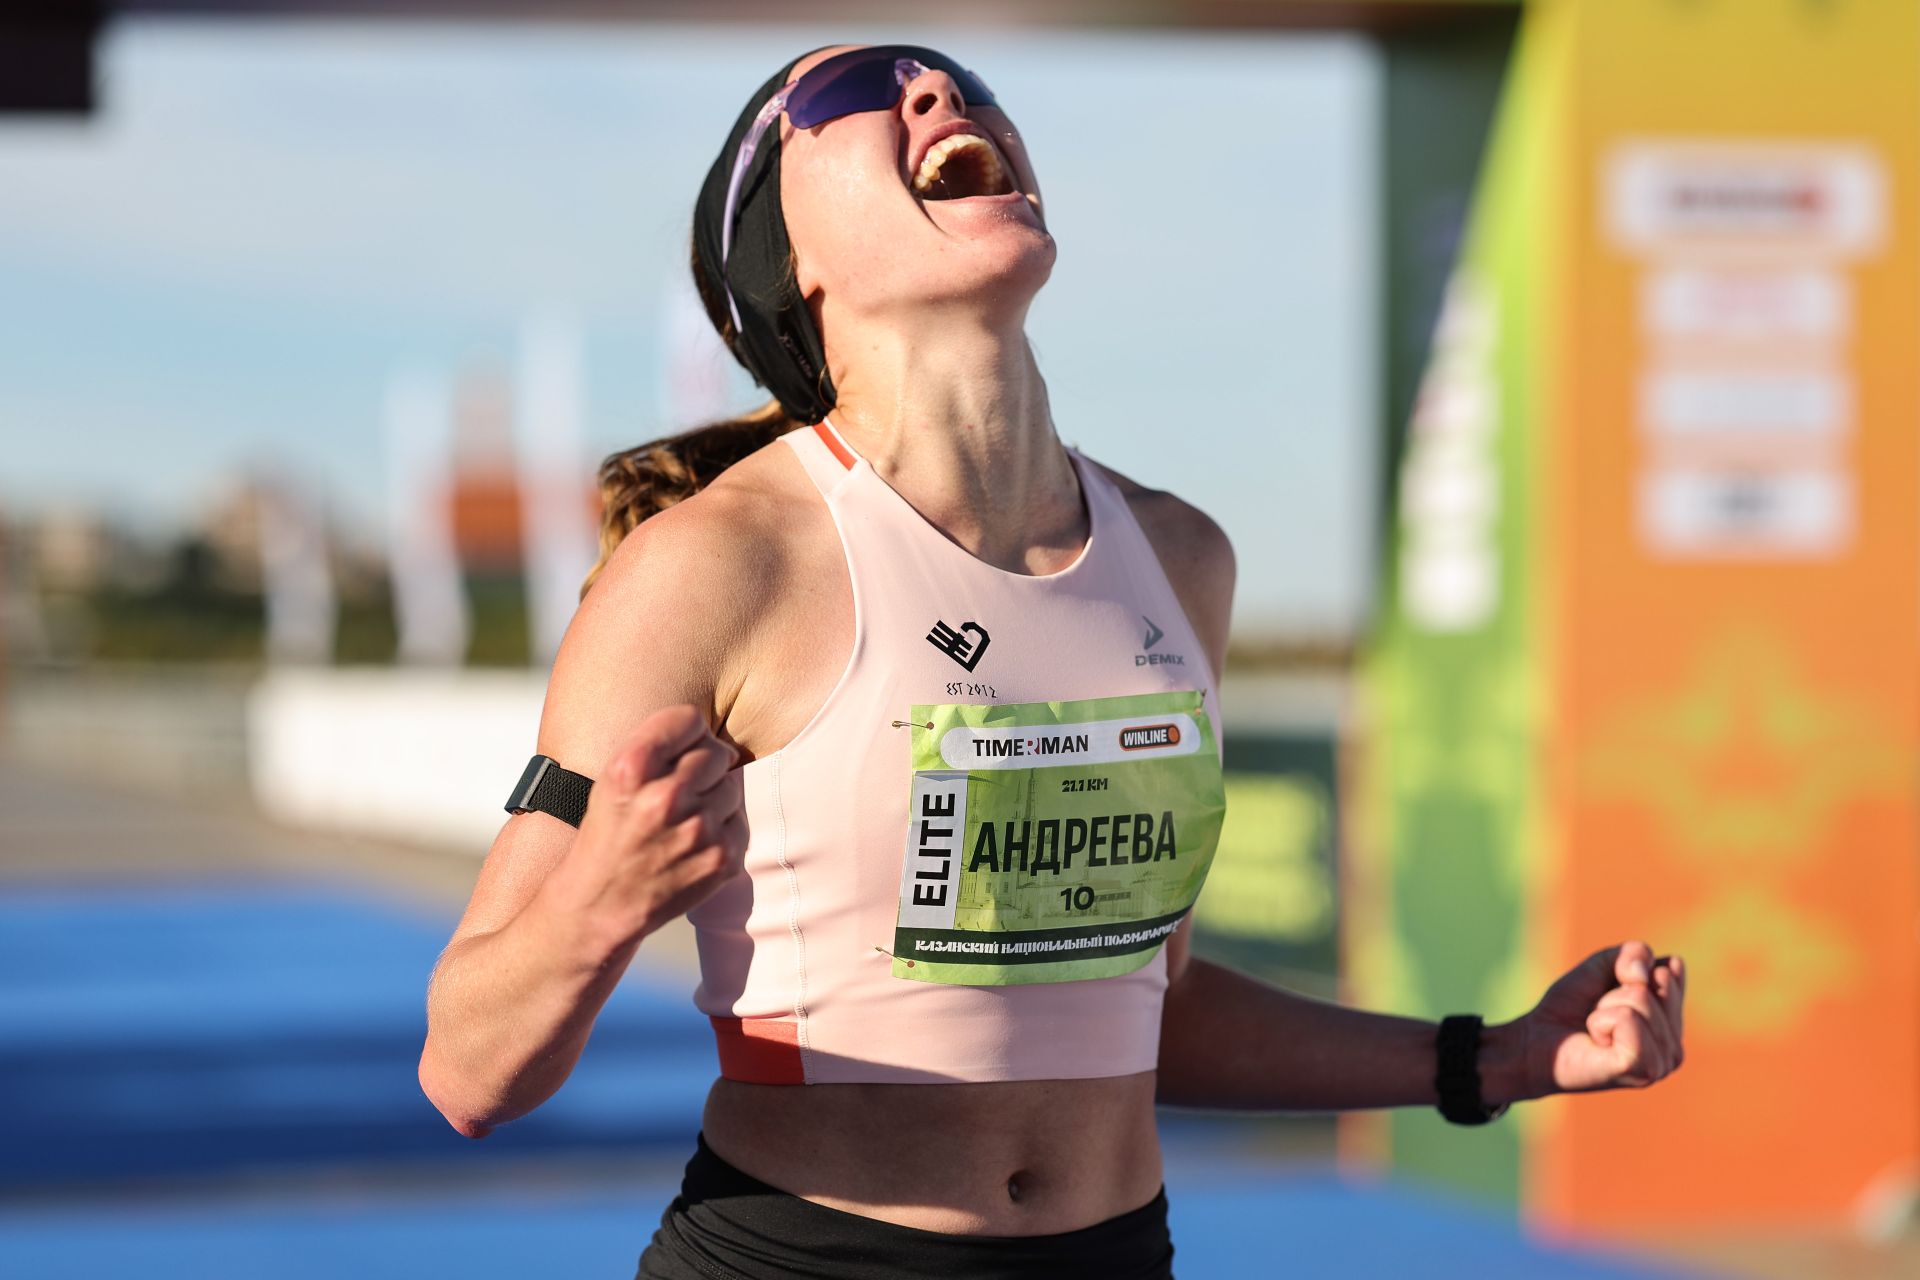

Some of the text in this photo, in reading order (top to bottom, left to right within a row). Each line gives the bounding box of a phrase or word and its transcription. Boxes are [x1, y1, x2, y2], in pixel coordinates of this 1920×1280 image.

[1135, 653, 1185, 667] DEMIX
[946, 682, 998, 699] EST 2012
[972, 734, 1089, 757] TIMERMAN
[1123, 728, 1168, 746] WINLINE
[912, 793, 956, 907] ELITE
[968, 810, 1177, 877] АНДРЕЕВА
[1060, 886, 1095, 912] 10
[915, 939, 999, 954] КАЗАНСКИЙ
[1001, 934, 1103, 956] НАЦИОНАЛЬНЫЙ
